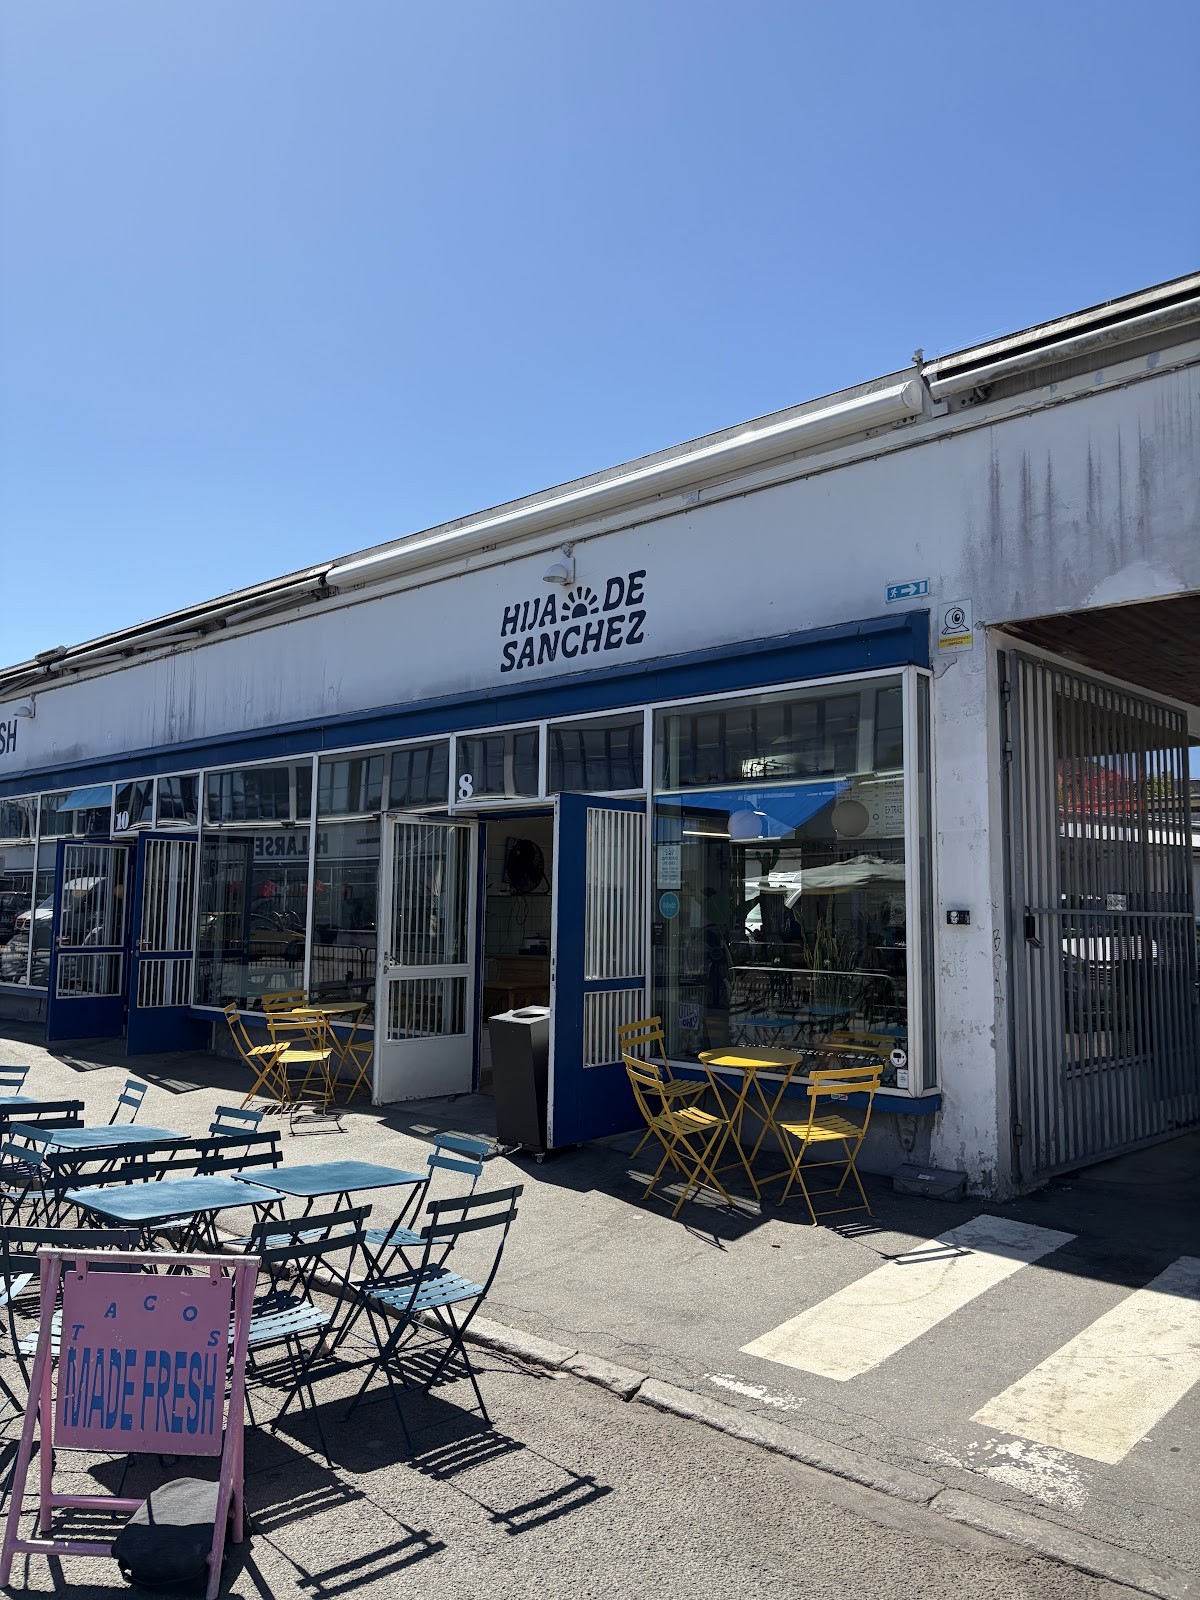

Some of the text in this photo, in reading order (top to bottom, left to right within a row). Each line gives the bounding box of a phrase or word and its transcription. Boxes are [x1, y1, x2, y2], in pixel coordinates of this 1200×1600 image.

[501, 570, 647, 637] HIJA DE
[501, 610, 647, 672] SANCHEZ
[458, 773, 474, 800] 8
[116, 811, 129, 830] 10
[72, 1295, 221, 1347] TACOS
[64, 1347, 217, 1435] MADE FRESH
